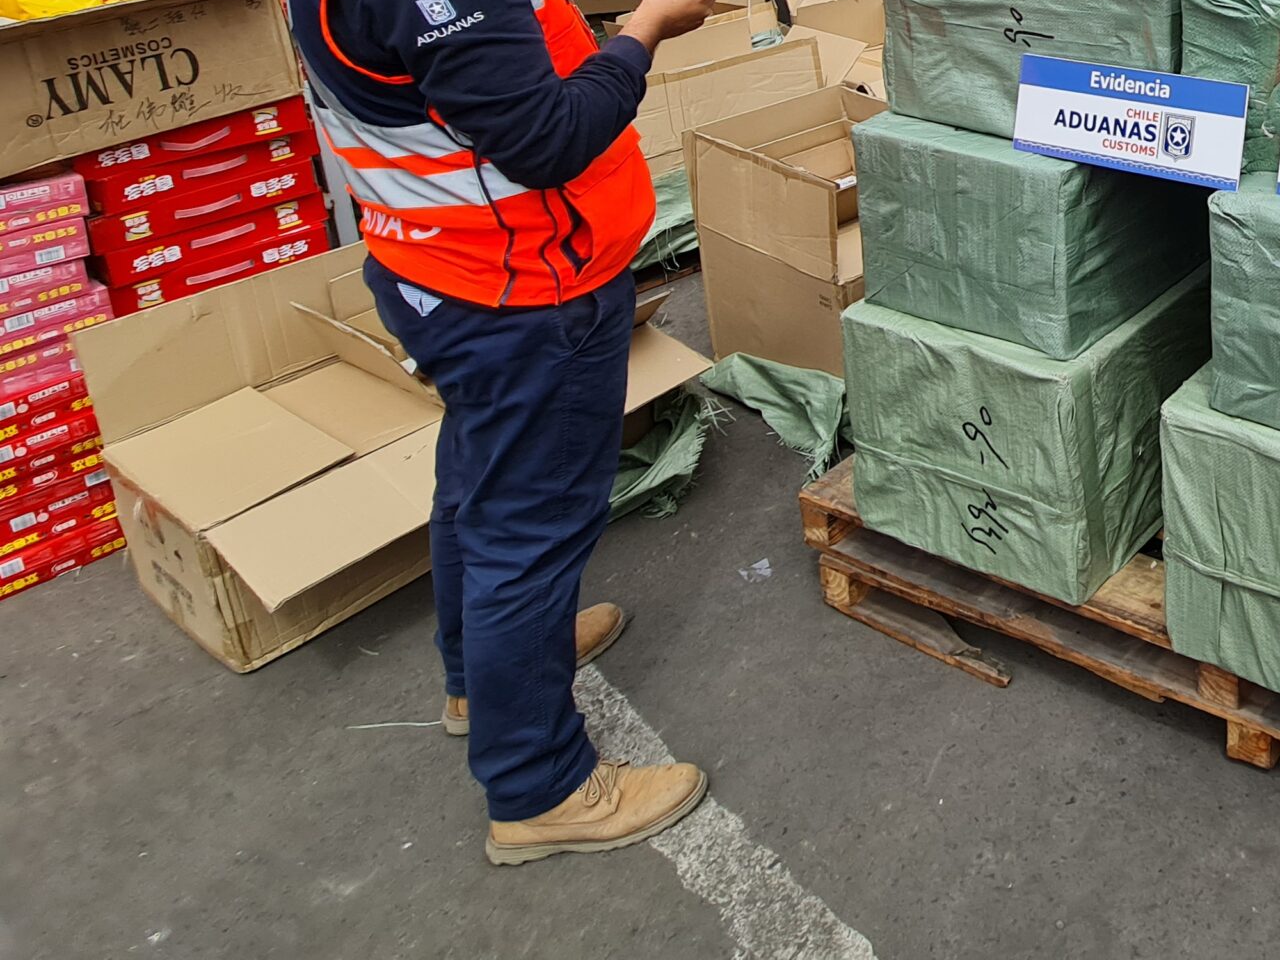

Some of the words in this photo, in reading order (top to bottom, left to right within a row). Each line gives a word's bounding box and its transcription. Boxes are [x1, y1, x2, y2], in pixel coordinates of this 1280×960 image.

[417, 11, 485, 47] ADUANAS
[67, 36, 172, 70] COSMETICS
[41, 47, 199, 121] CLAMY
[1089, 70, 1171, 99] Evidencia
[1053, 109, 1158, 143] ADUANAS
[1126, 108, 1159, 123] CHILE
[1101, 138, 1156, 157] CUSTOMS
